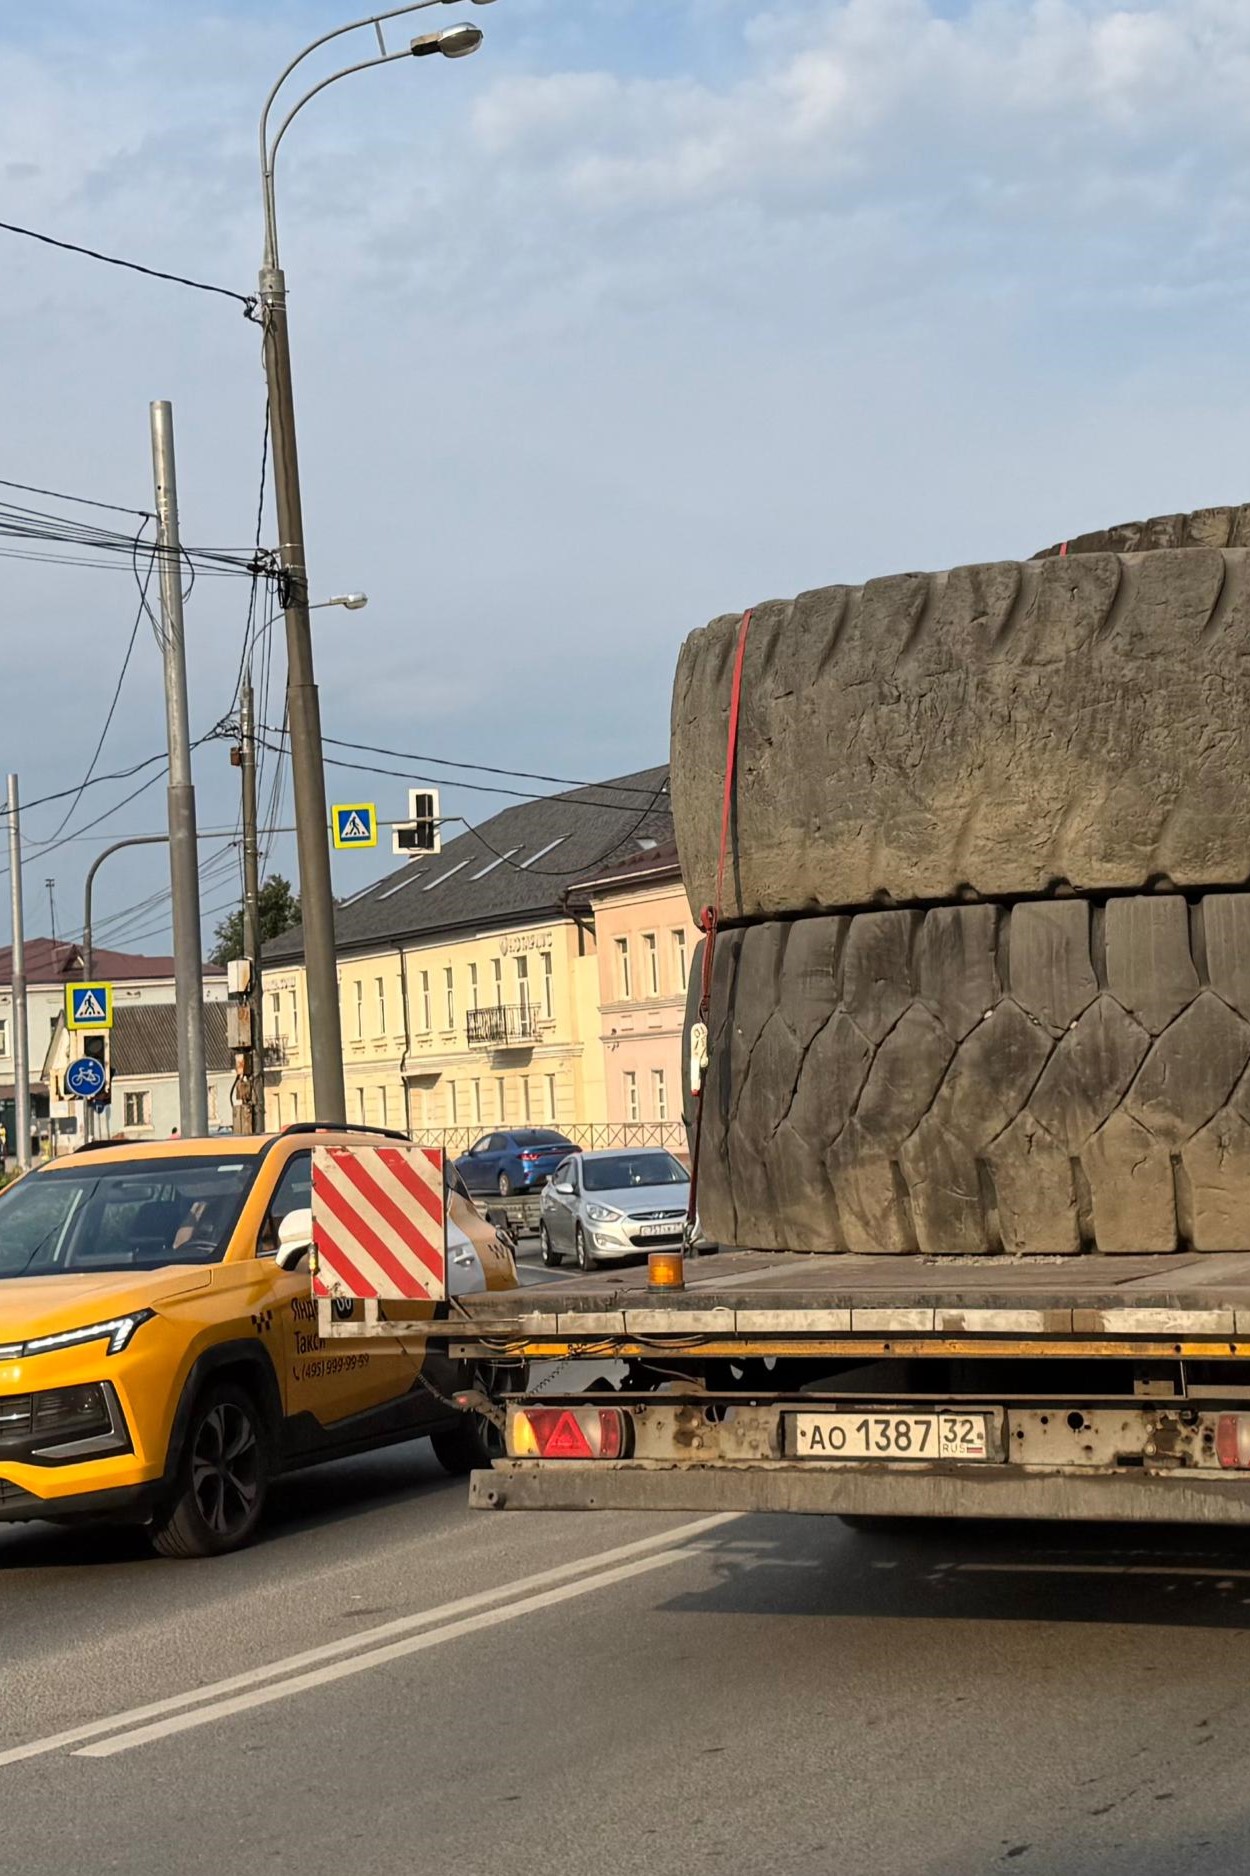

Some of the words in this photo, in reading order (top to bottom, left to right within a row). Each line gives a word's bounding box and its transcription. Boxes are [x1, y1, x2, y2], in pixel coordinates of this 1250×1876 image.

[301, 1361, 325, 1380] (495)
[809, 1425, 846, 1450] АО
[856, 1419, 932, 1452] 1387
[943, 1419, 974, 1443] 32
[943, 1444, 966, 1453] RUS
